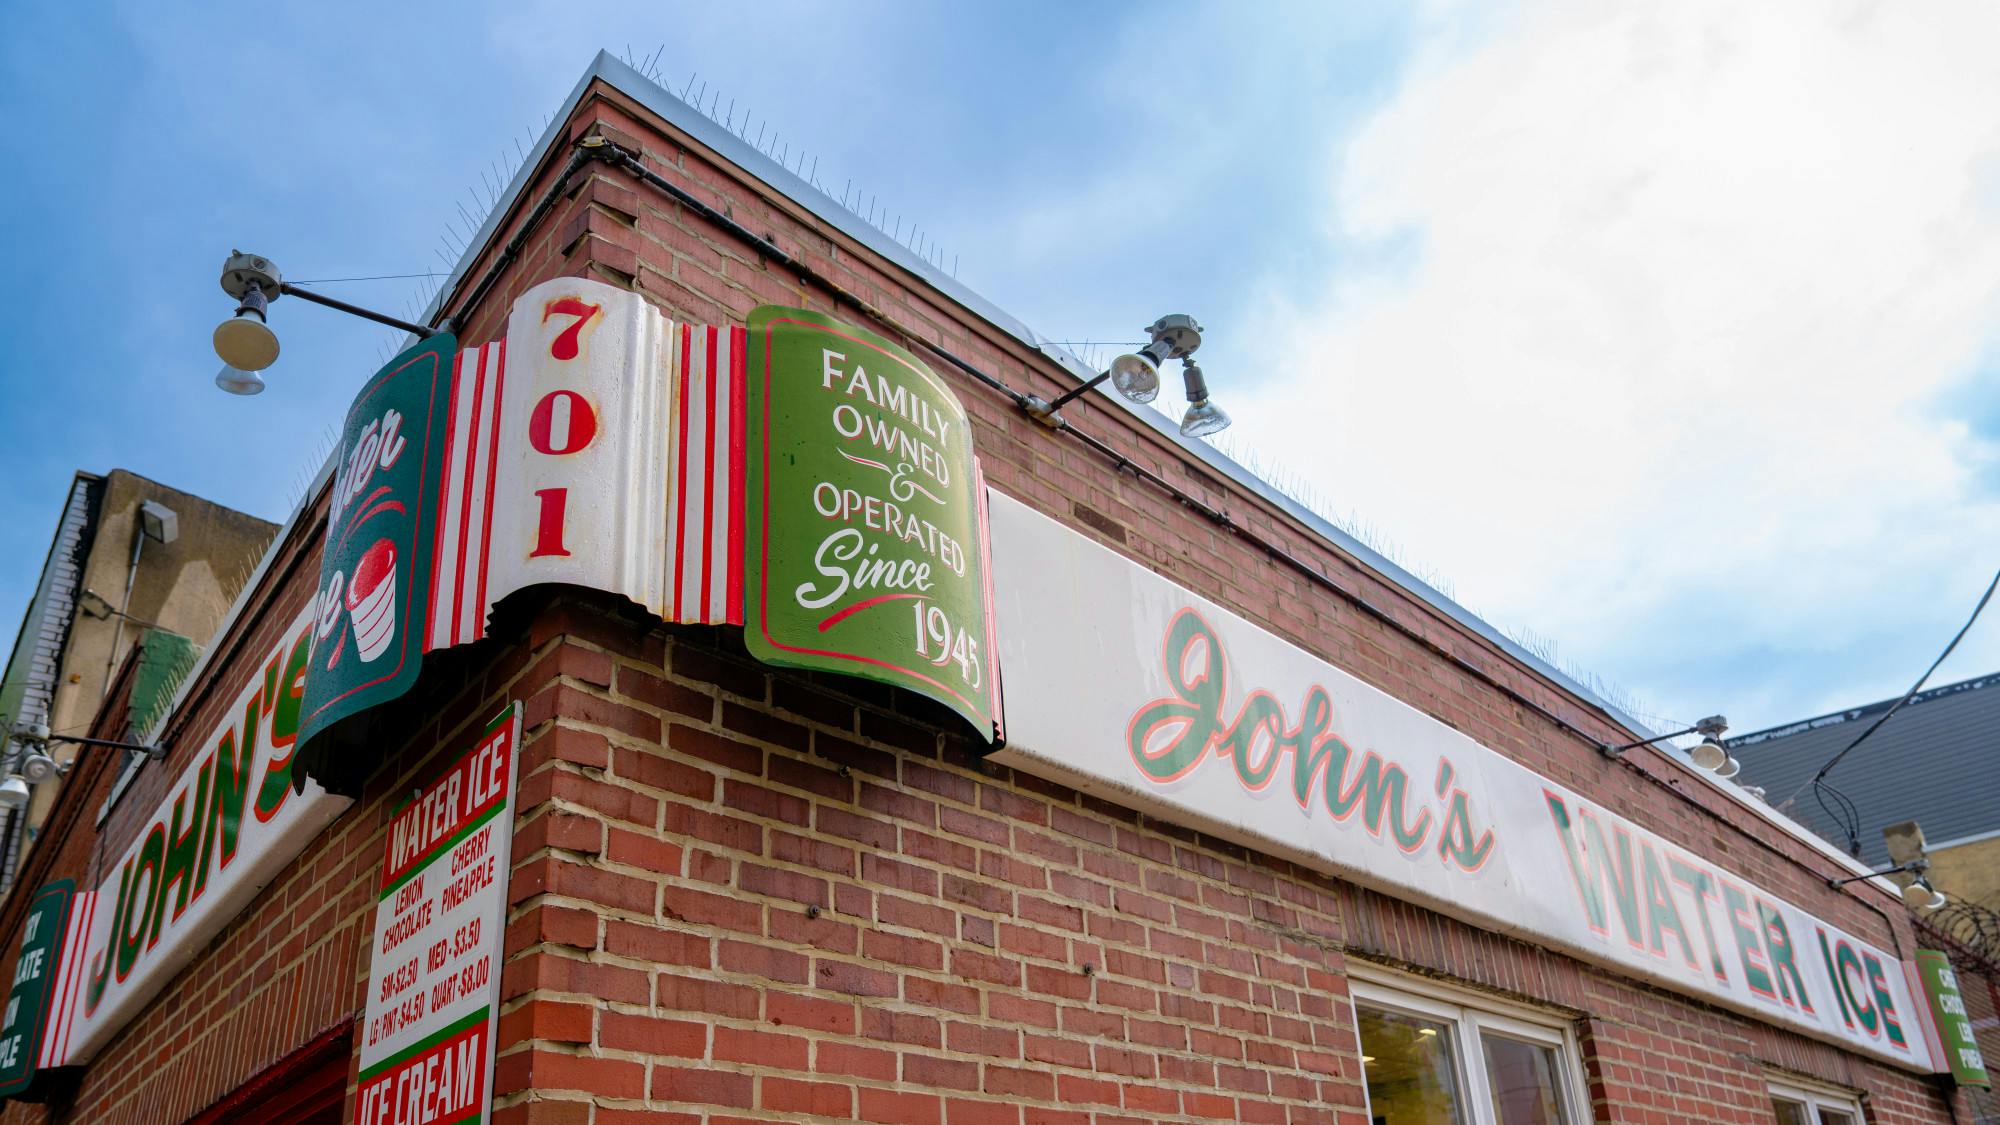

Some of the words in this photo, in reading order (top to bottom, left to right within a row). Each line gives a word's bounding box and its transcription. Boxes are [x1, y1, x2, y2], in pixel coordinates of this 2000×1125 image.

[528, 296, 601, 558] 701
[821, 347, 950, 448] FAMILY
[833, 404, 950, 488] OWNED
[795, 528, 934, 609] Since
[813, 482, 966, 578] OPERATED
[912, 599, 981, 694] 1945
[84, 621, 312, 1019] JOHN'S
[390, 768, 462, 876] WATER
[465, 731, 506, 816] ICE
[1127, 606, 1495, 873] John's
[1541, 786, 1816, 1018] WATER
[1815, 926, 1909, 1050] ICE
[382, 898, 433, 954] CHOCOLATE
[441, 855, 495, 916] PINEAPPLE
[394, 874, 425, 918] LEMON
[451, 825, 492, 877] CHERRY
[360, 1078, 392, 1125] ICE
[394, 1033, 480, 1125] CREAM
